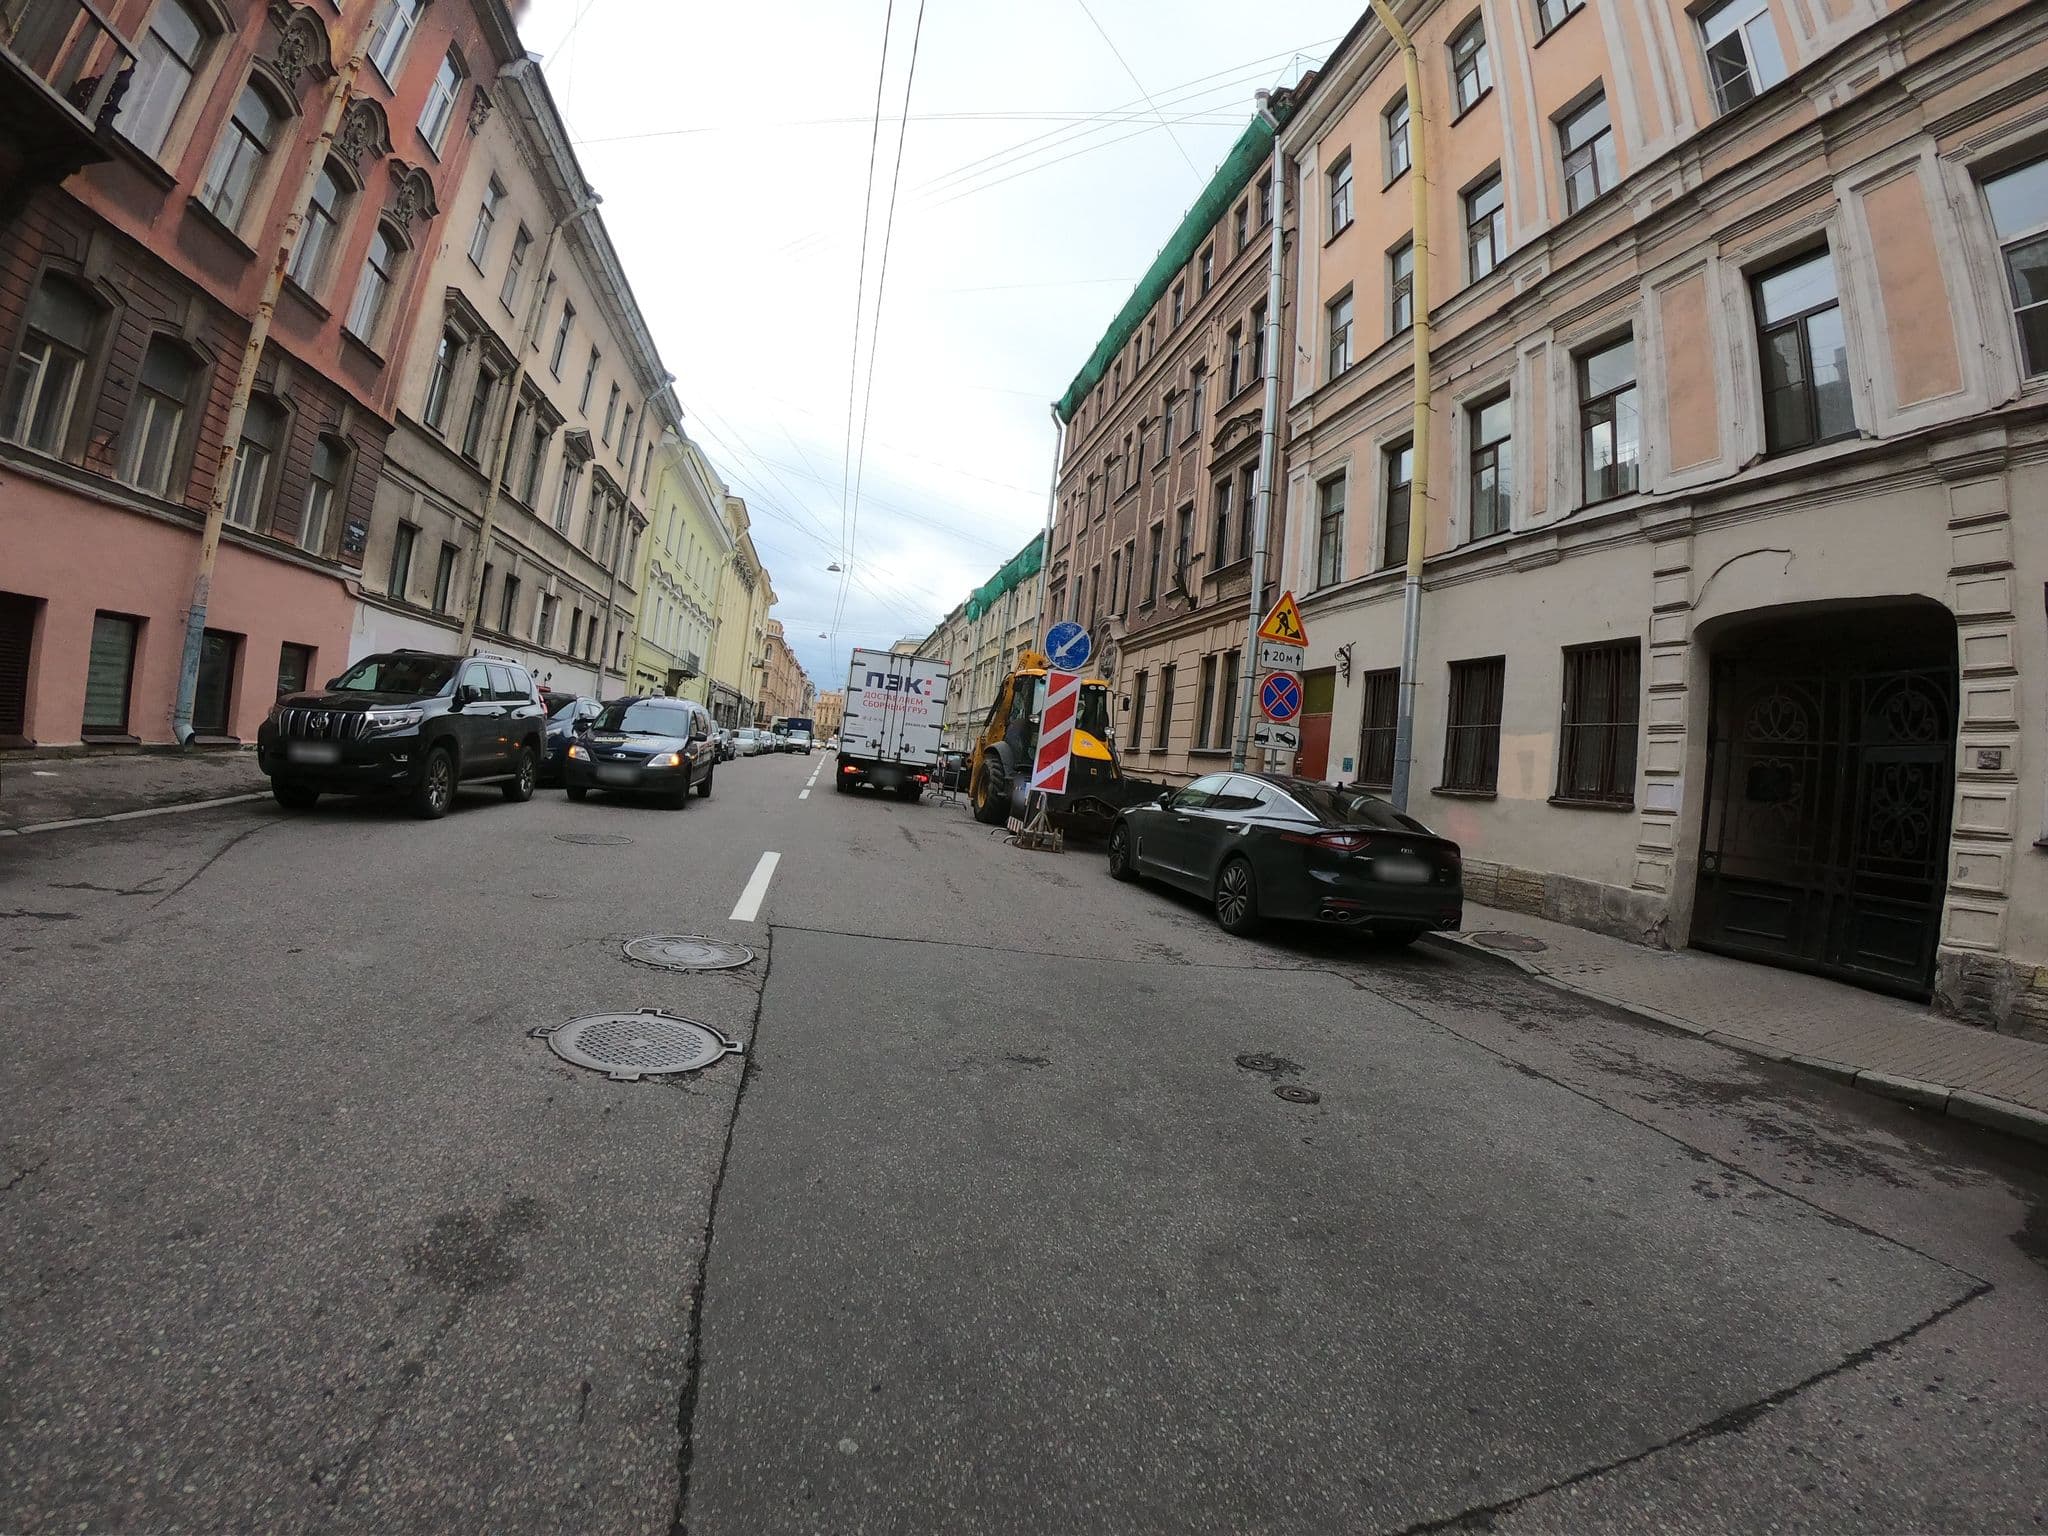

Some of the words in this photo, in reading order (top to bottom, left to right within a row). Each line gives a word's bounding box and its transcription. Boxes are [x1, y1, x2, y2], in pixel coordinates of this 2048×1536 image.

[864, 691, 923, 705] ДОСТАВЛЯЕМ
[863, 699, 907, 713] СБОРНЫЙ
[907, 706, 928, 715] ГРУЗ
